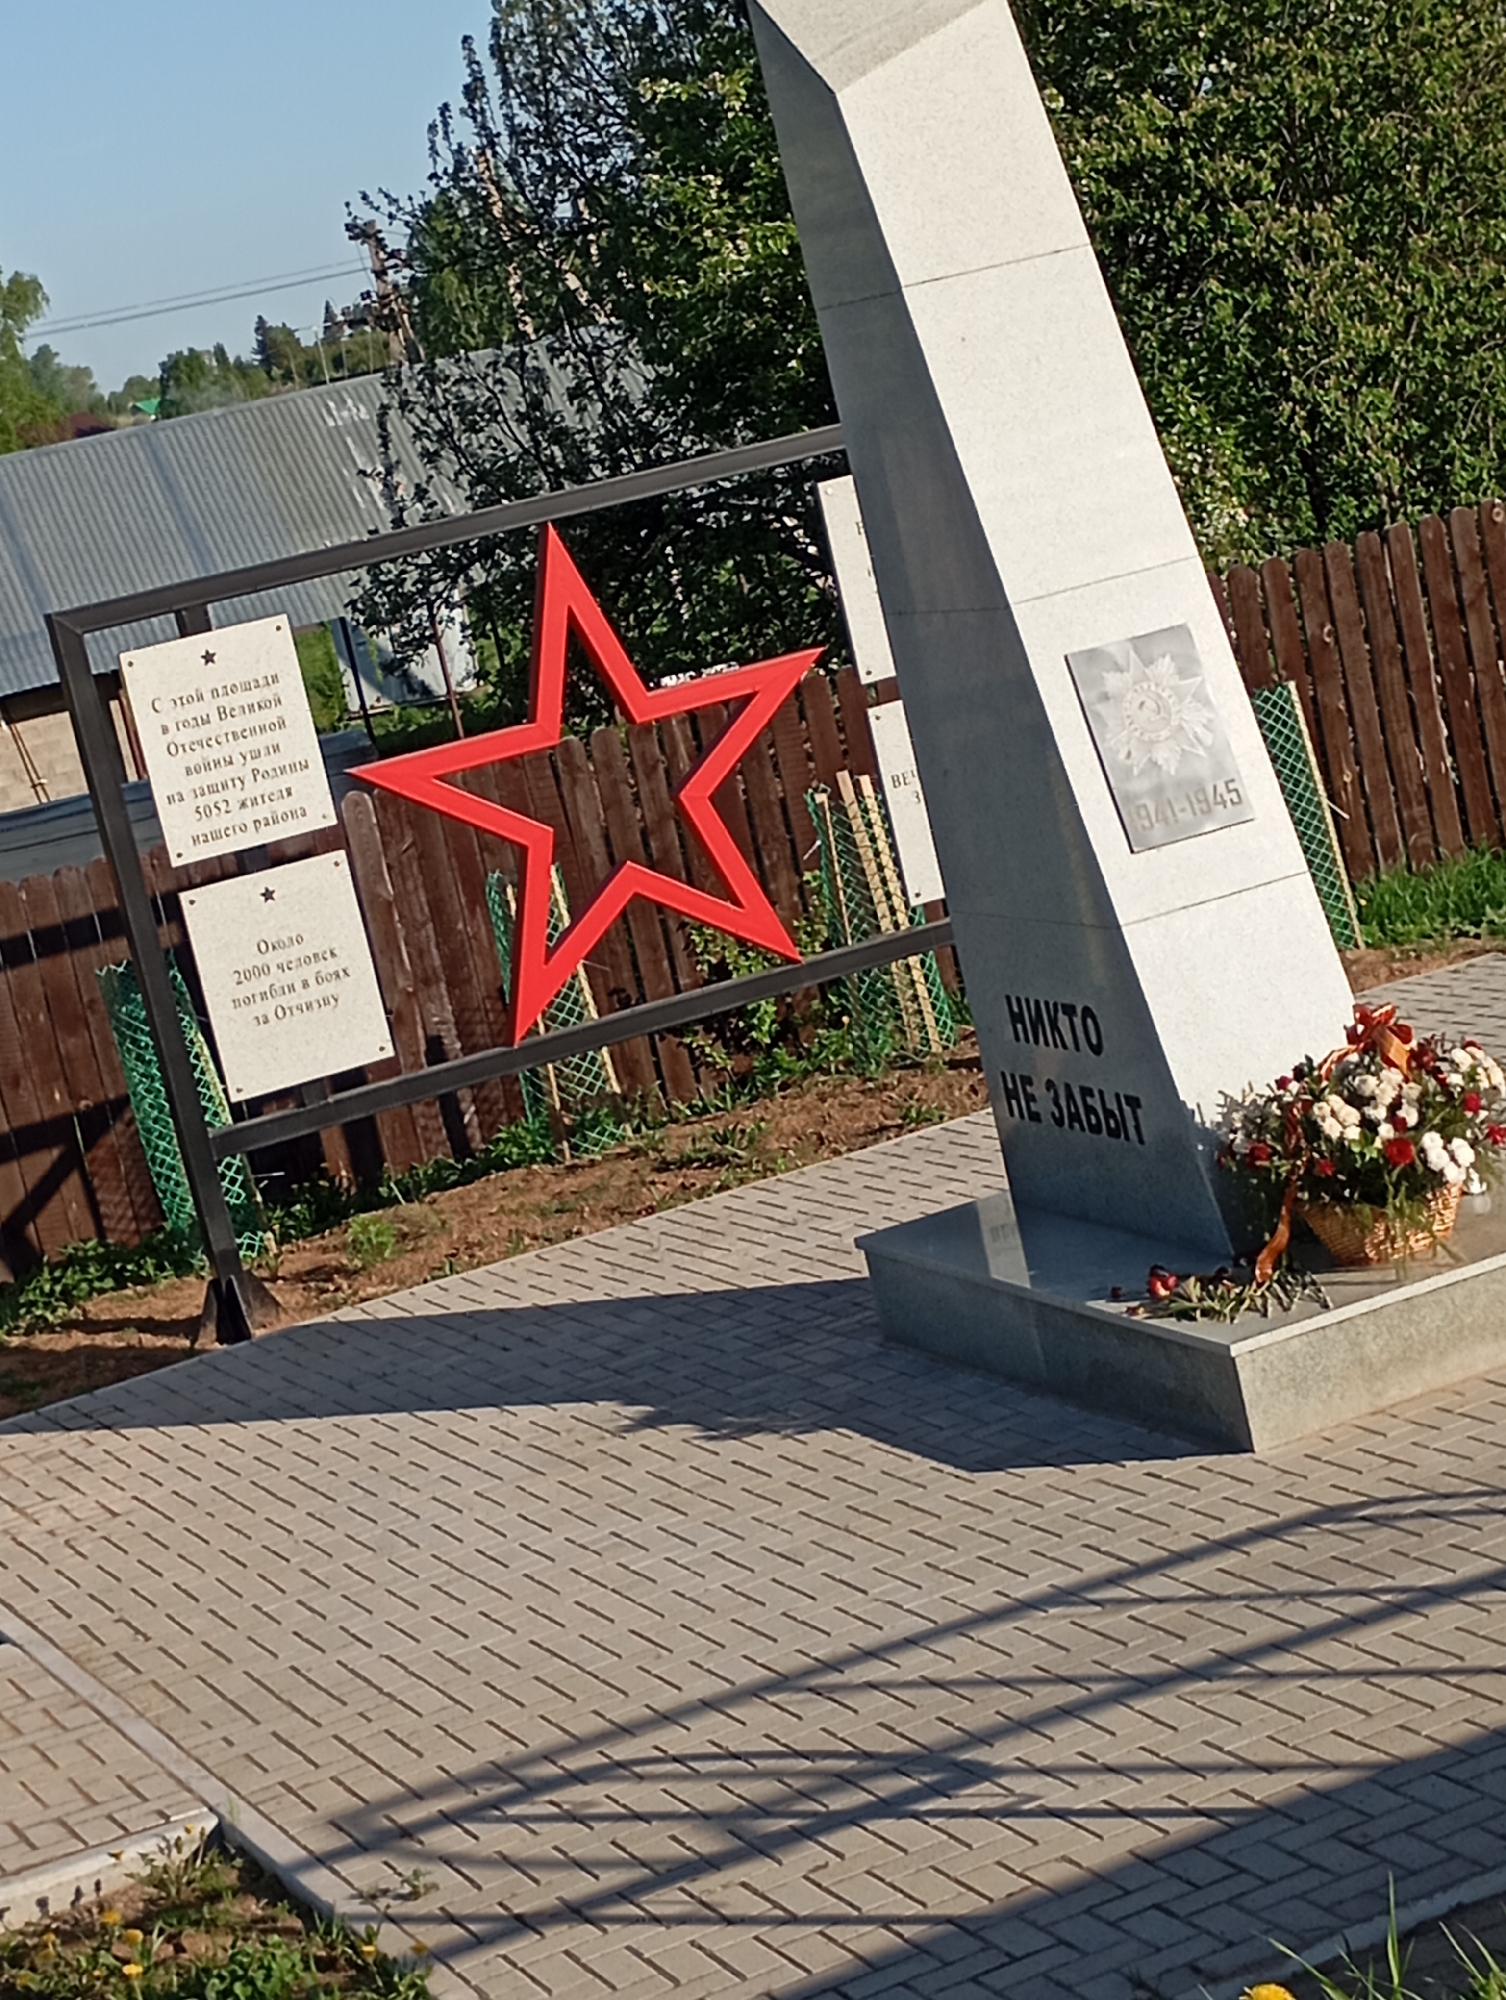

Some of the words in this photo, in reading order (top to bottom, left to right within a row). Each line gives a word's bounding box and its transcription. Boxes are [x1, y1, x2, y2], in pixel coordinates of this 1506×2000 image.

[151, 697, 162, 714] С
[171, 688, 204, 709] этой
[211, 672, 280, 700] площади
[161, 723, 169, 736] в
[175, 713, 211, 732] годы
[216, 693, 283, 722] Великой
[166, 716, 287, 757] Отечественной
[185, 754, 234, 777] войны
[239, 742, 281, 766] ушли
[166, 790, 185, 806] на
[192, 774, 246, 800] защиту
[251, 759, 310, 783] Родины
[194, 799, 232, 822] 5052
[238, 785, 293, 811] жителя
[191, 822, 248, 847] нашего
[253, 805, 308, 834] района
[256, 933, 304, 955] Около
[233, 963, 271, 986] 2000
[276, 947, 338, 974] человек
[231, 982, 296, 1010] погибли
[302, 978, 310, 990] в
[314, 966, 351, 986] боях
[253, 1014, 270, 1027] за
[274, 993, 340, 1021] Отчизну
[1005, 993, 1104, 1057] НИКТО
[1000, 1070, 1042, 1124] НЕ
[1045, 1078, 1145, 1146] ЗАБЫТ
